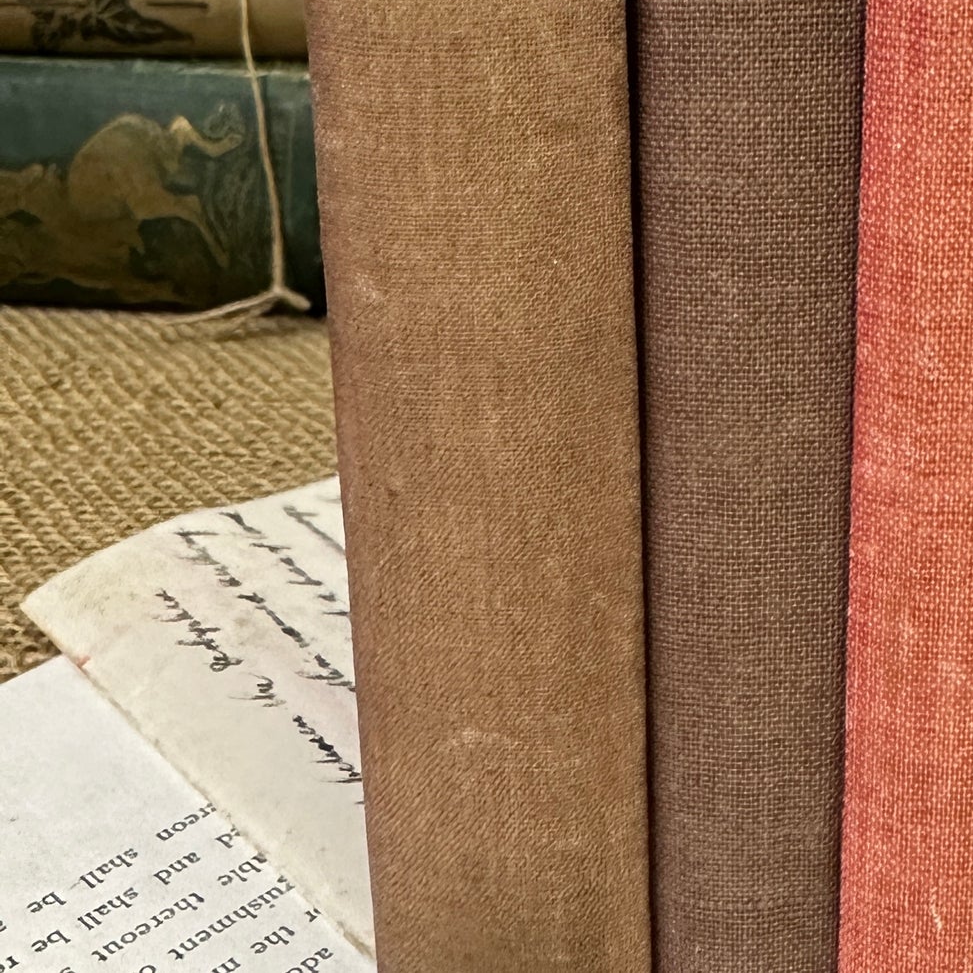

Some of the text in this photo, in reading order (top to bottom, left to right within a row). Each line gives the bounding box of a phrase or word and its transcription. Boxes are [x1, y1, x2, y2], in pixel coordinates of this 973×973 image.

[79, 848, 139, 889] shall
[153, 852, 202, 885] and
[26, 891, 67, 914] be
[77, 886, 140, 931] shall
[31, 929, 72, 953] be
[91, 892, 205, 962] thereout
[250, 925, 296, 955] the
